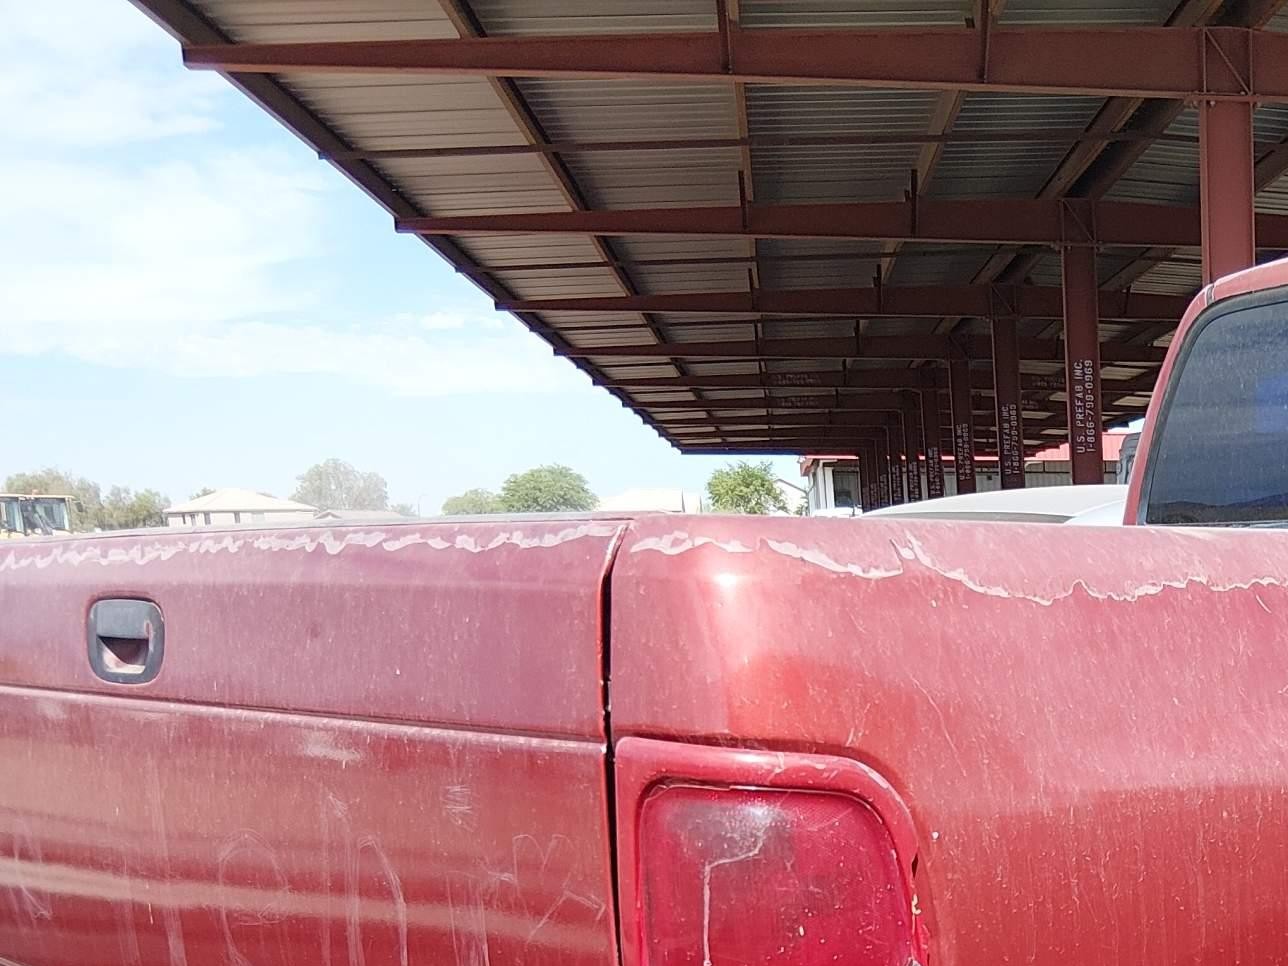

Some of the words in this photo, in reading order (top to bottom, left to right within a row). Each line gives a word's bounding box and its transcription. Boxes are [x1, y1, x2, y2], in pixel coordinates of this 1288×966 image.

[1073, 359, 1084, 379] INC.
[1075, 385, 1085, 427] PREFAB
[1076, 432, 1086, 453] U.S.
